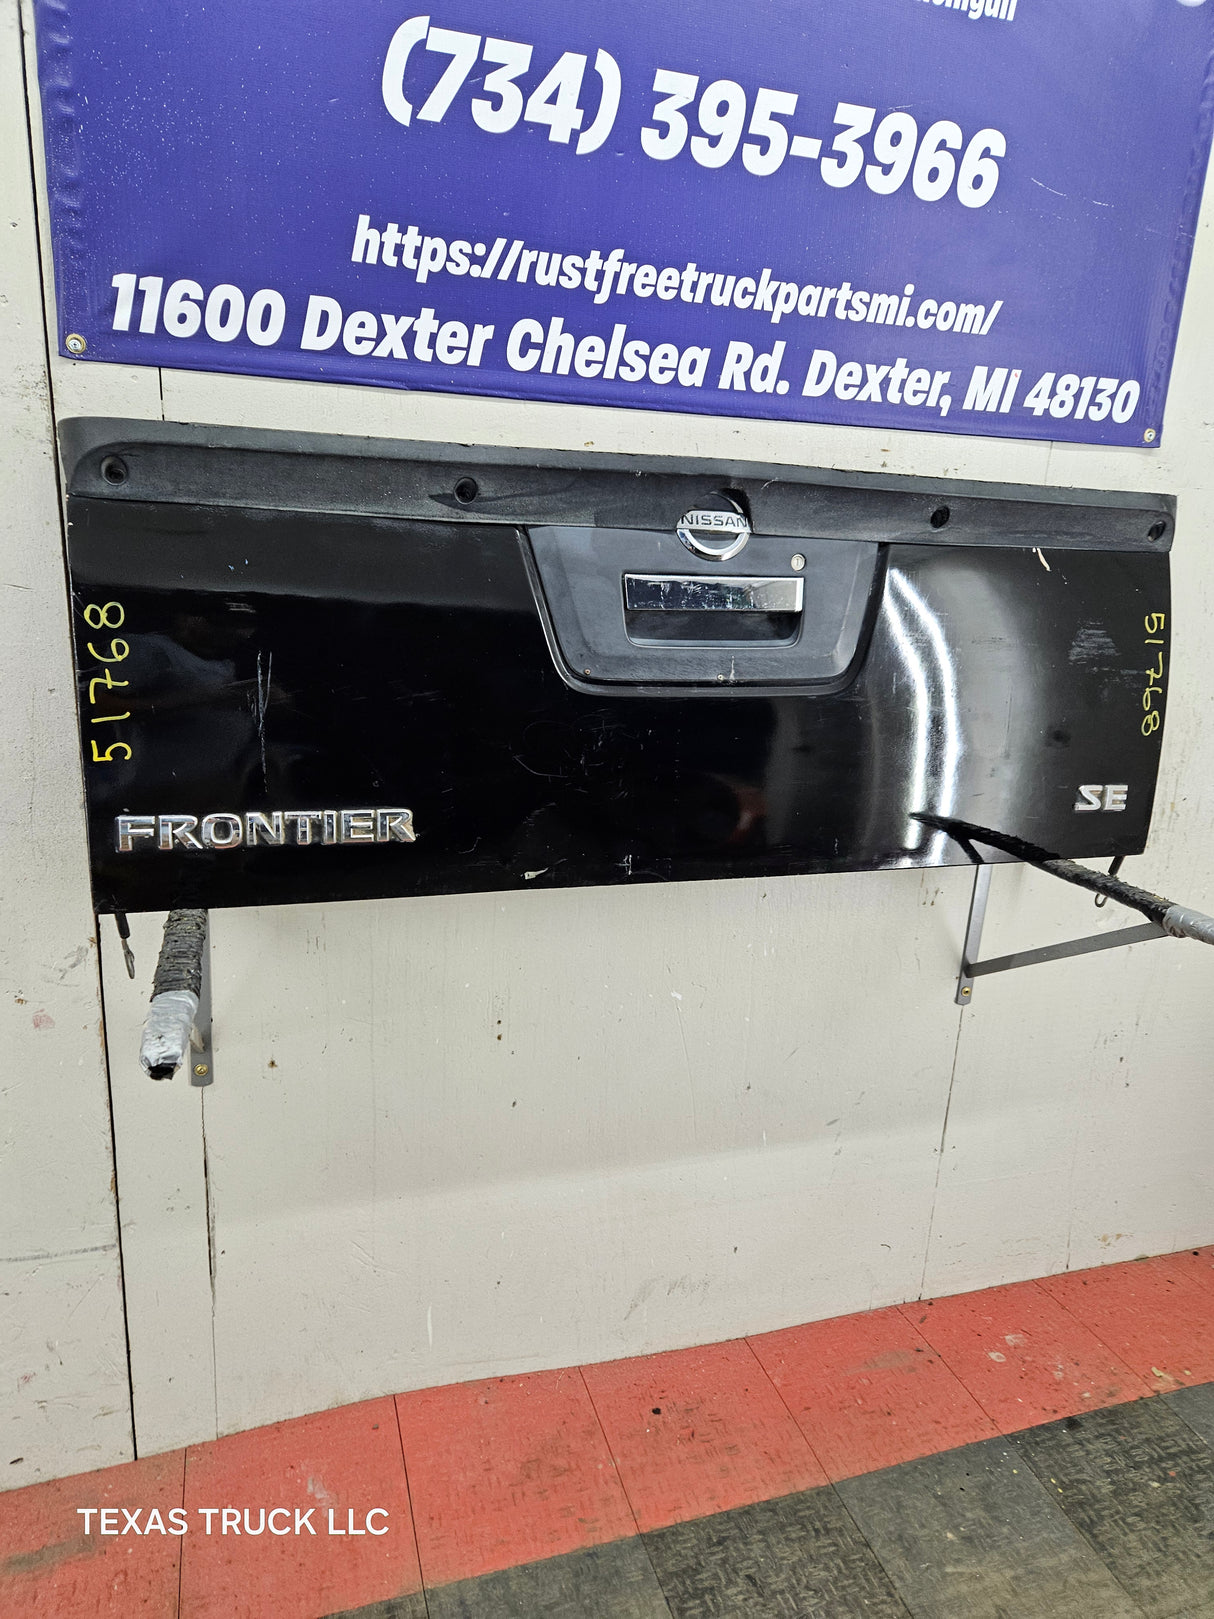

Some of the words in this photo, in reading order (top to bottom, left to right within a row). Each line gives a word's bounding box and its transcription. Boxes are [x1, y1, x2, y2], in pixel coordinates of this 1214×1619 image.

[381, 15, 622, 155] (734)
[640, 68, 1007, 209] 395-3966
[351, 214, 1004, 336] https://rustfreetruckpartsmi.com/
[111, 273, 286, 346] 11600
[300, 294, 495, 367] Dexter
[506, 316, 712, 387] Chelsea
[717, 340, 790, 395] Rd.
[801, 349, 952, 417] Dexter,
[962, 365, 1023, 414] MI
[1022, 372, 1141, 424] 48130
[680, 513, 749, 529] NISSAN
[83, 601, 132, 763] 51768
[1141, 612, 1166, 737] 51768
[115, 808, 417, 852] FRONTIER
[1073, 784, 1129, 812] SE
